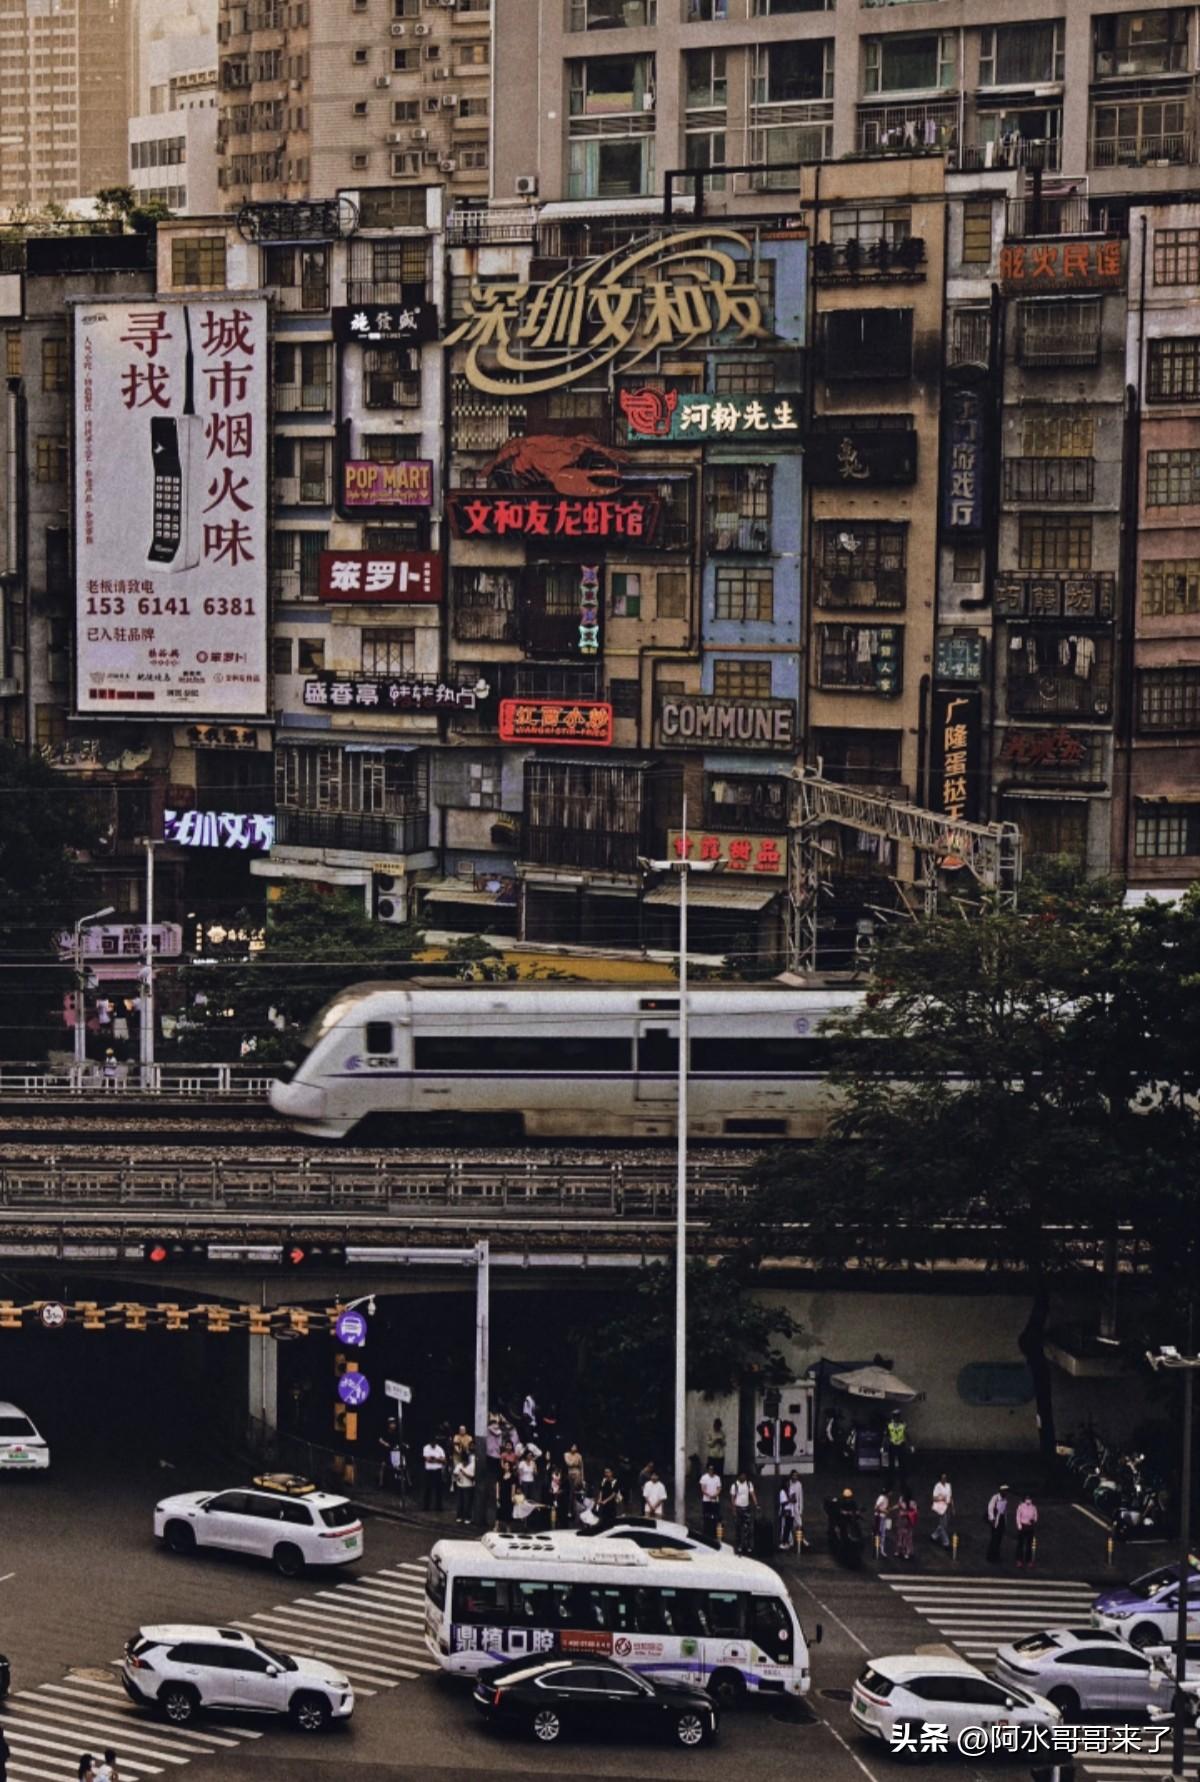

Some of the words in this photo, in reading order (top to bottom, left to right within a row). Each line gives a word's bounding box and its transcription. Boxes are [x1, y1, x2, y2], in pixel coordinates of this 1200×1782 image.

[442, 250, 776, 362] 深圳文和友
[120, 310, 172, 410] 寻找
[680, 401, 799, 431] 河粉先生
[201, 309, 254, 566] 城市烟火味
[346, 466, 377, 489] POP
[383, 466, 429, 489] MART
[463, 501, 646, 536] 文和友龙虾馆
[86, 579, 155, 594] 老板请致电
[330, 560, 420, 592] 笨罗卜
[86, 597, 125, 616] 153
[138, 597, 191, 616] 6141
[203, 597, 256, 616] 6381
[86, 627, 155, 642] 已入驻品牌
[305, 681, 379, 706] 盛香亭
[662, 705, 792, 742] COMMUNE
[455, 1625, 555, 1652] 鼎植口腔
